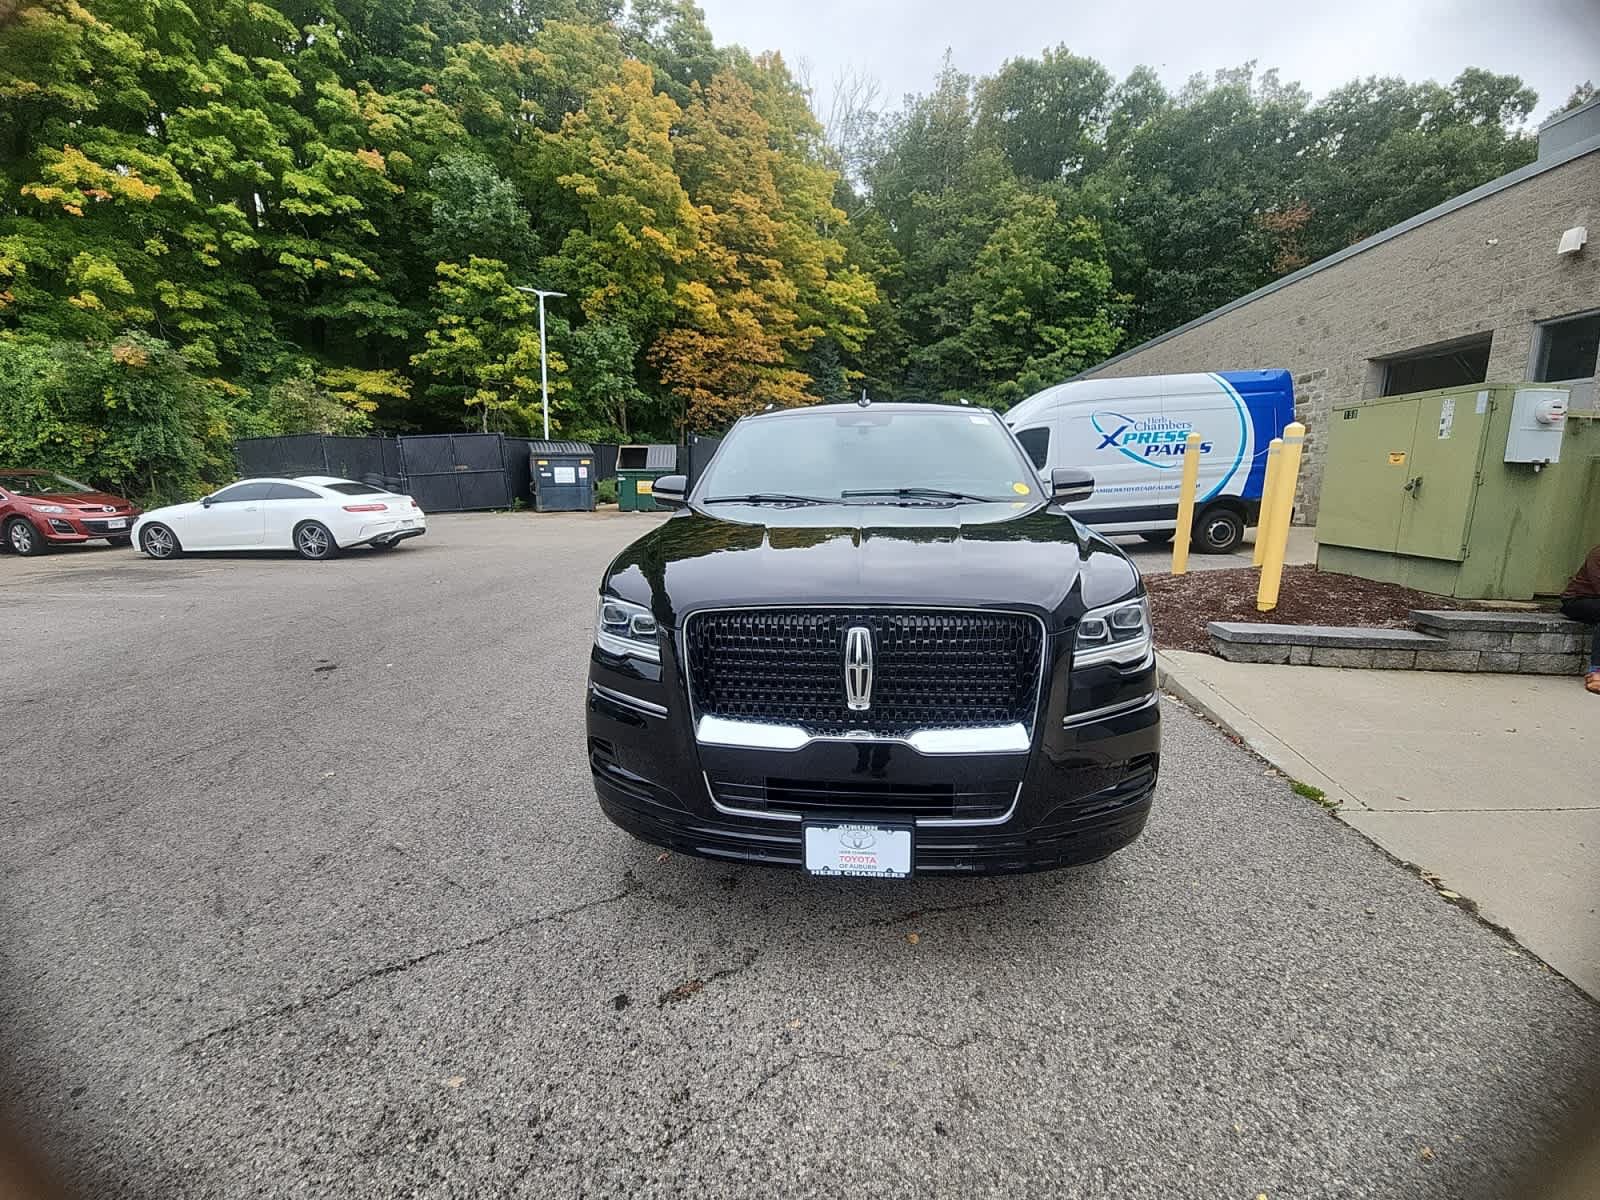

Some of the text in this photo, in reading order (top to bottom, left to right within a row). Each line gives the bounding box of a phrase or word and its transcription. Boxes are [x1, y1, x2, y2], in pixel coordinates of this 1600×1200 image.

[1147, 416, 1168, 424] Herb
[1134, 421, 1192, 431] Chambers
[1144, 441, 1214, 456] PARS
[839, 856, 877, 864] TOYOTA
